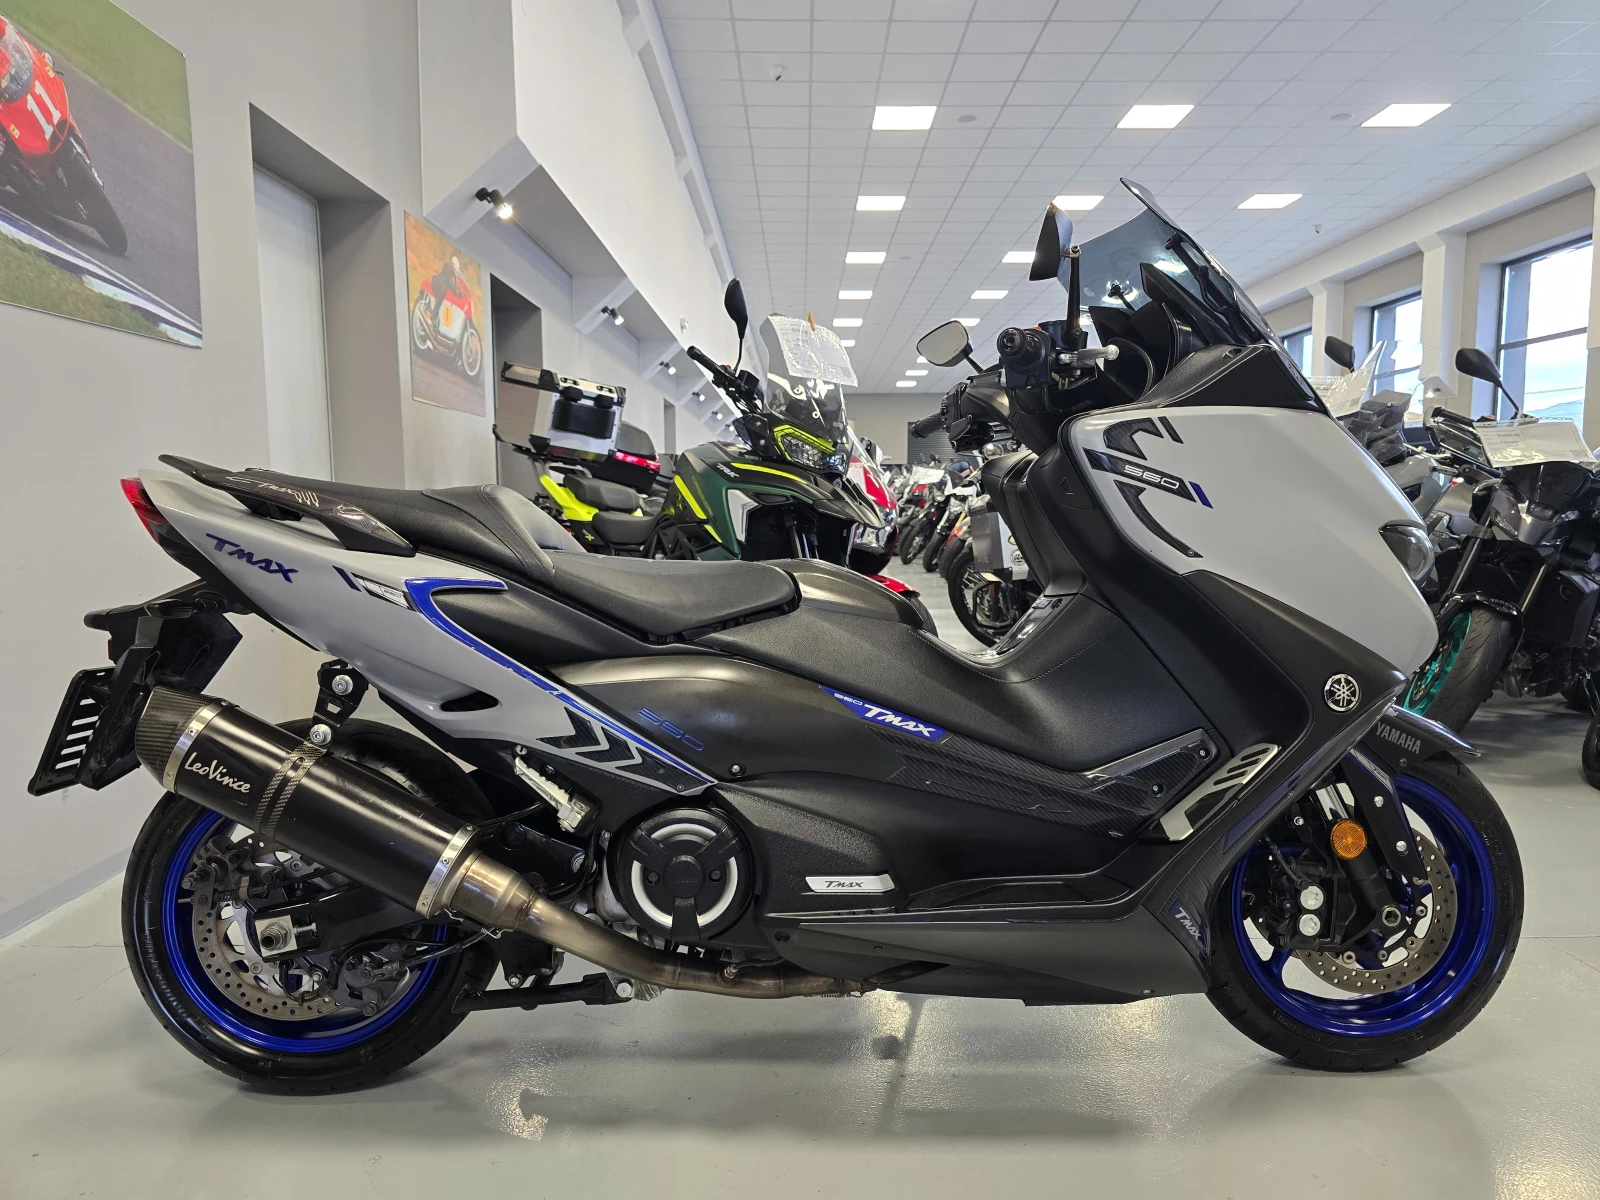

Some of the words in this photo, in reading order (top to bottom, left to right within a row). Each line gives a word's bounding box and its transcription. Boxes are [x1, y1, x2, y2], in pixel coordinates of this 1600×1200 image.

[27, 80, 61, 141] 11
[1124, 464, 1180, 490] 560
[205, 532, 299, 584] TMAX
[863, 703, 937, 737] TMAX
[1376, 721, 1421, 754] YAMAHA
[184, 751, 251, 793] LeoVince
[824, 880, 865, 888] TMAX
[1174, 906, 1202, 941] TMAX
